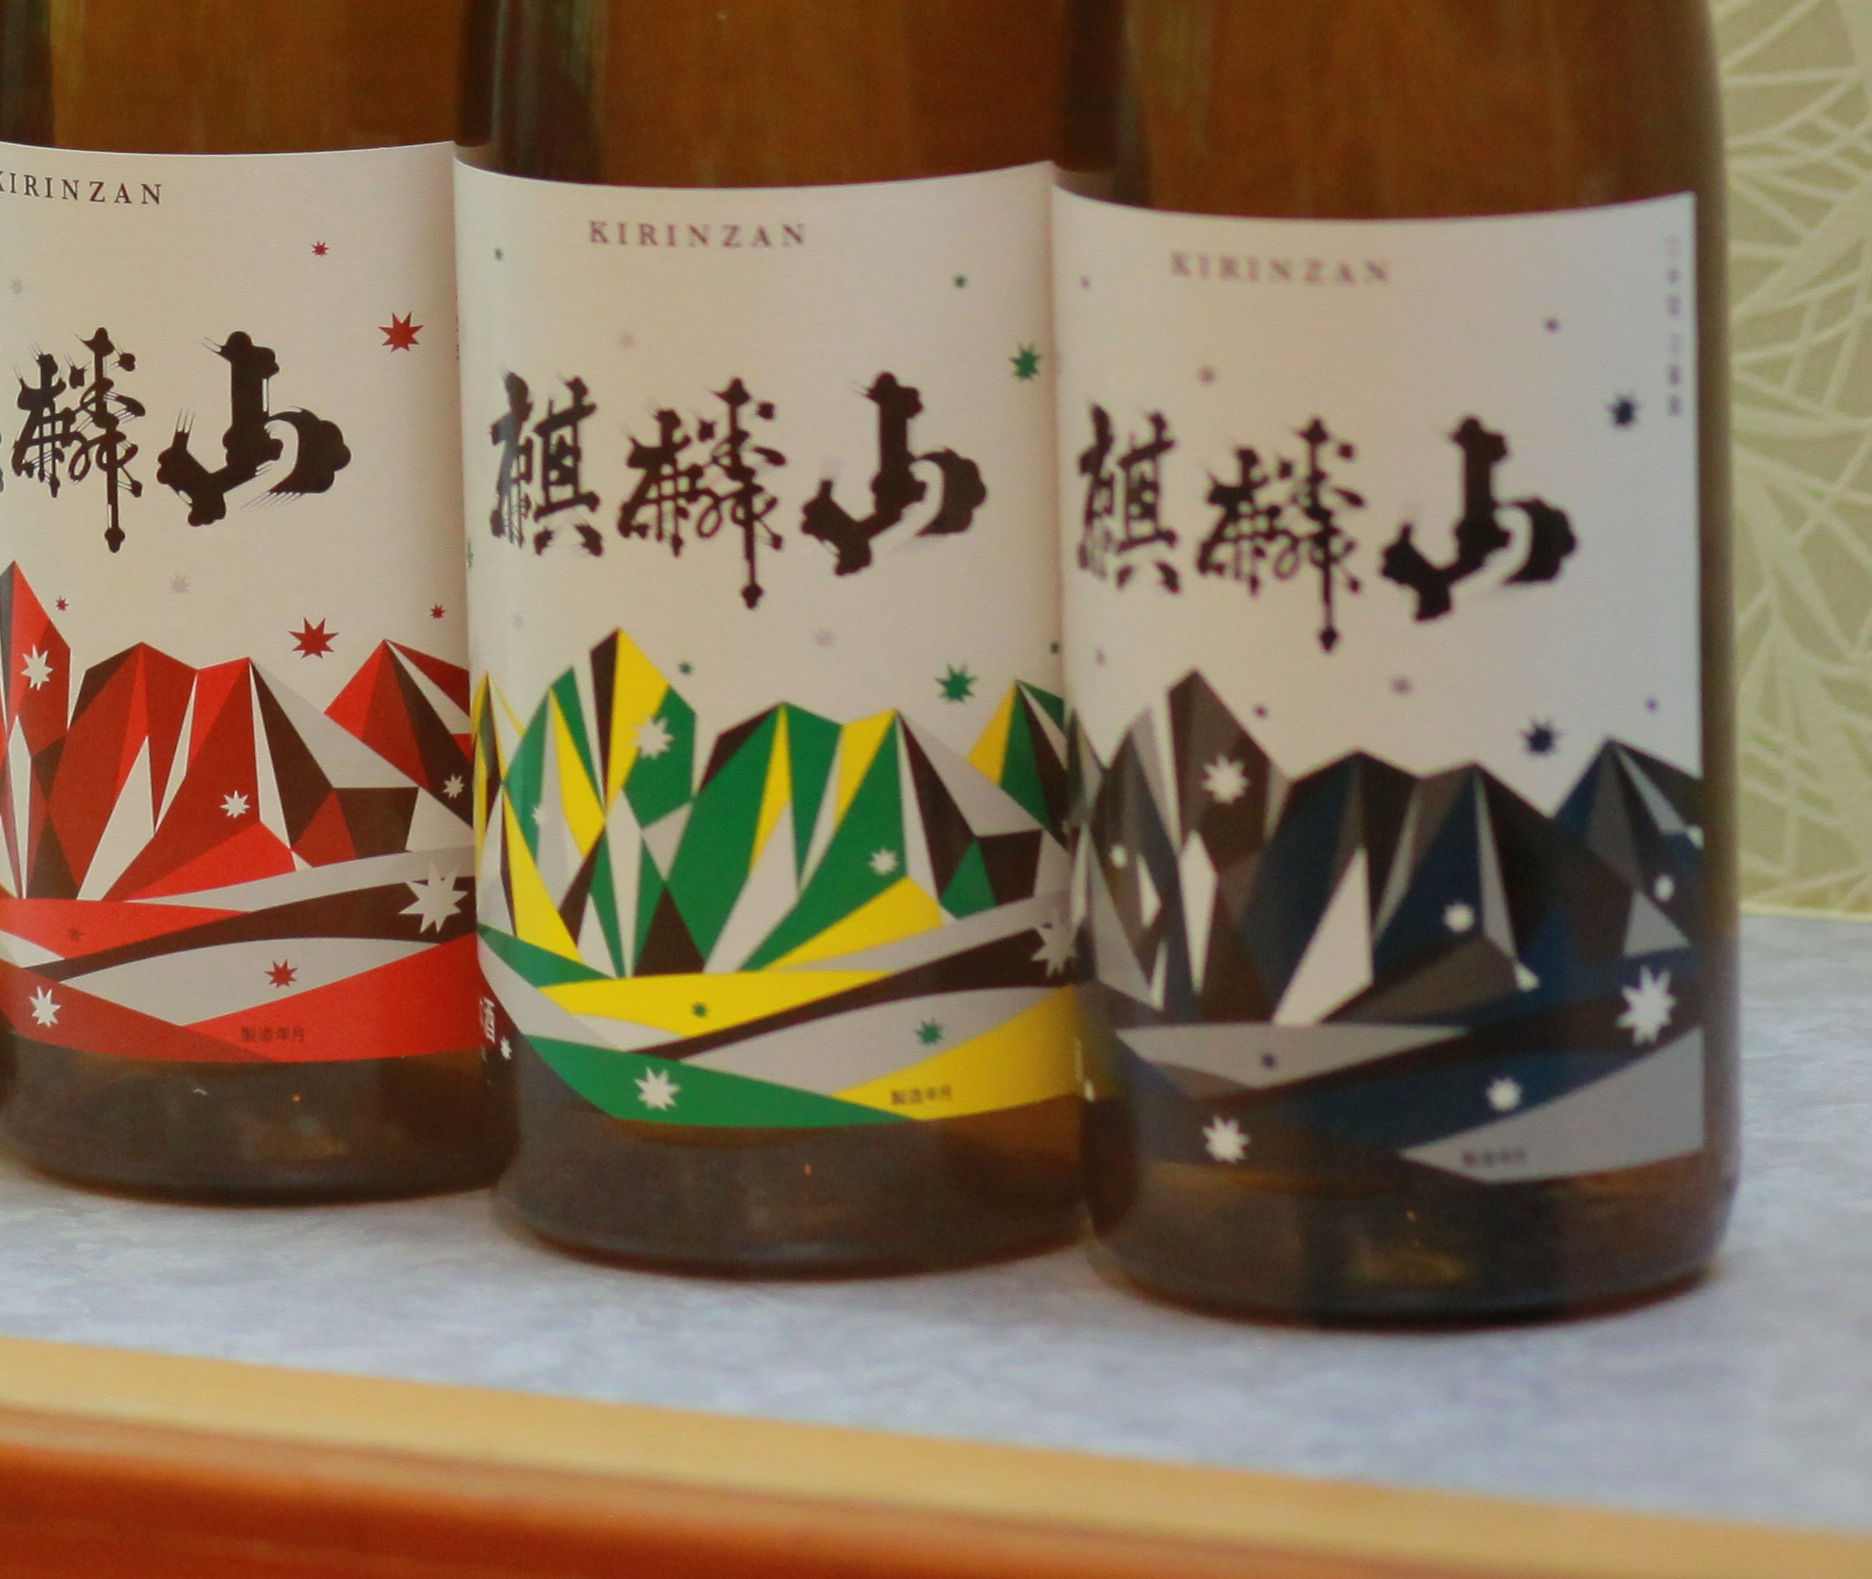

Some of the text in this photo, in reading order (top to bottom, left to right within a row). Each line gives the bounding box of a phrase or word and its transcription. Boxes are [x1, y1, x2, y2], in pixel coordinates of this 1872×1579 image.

[589, 220, 805, 248] KIRINZAN
[1170, 251, 1392, 284] KIRINZAN
[488, 368, 988, 610] 麒麟山
[1076, 404, 1578, 653] 麒麟山
